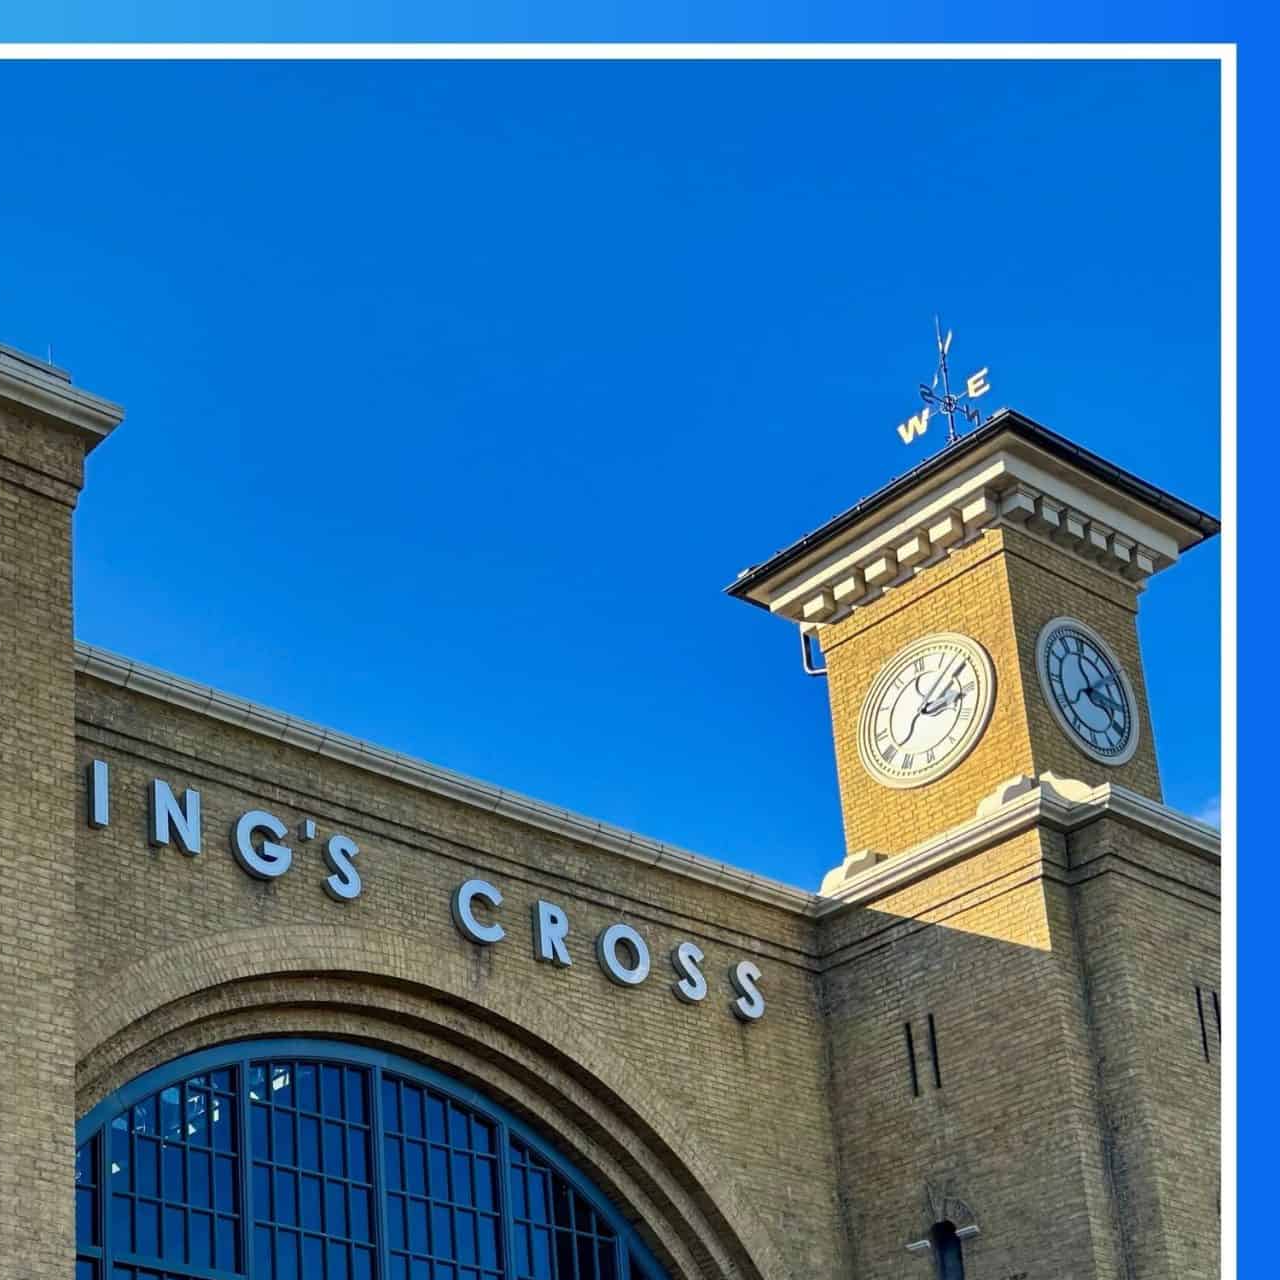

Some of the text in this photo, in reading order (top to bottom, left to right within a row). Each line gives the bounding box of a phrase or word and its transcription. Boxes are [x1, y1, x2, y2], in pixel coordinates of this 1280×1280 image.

[967, 367, 990, 398] E
[897, 407, 930, 445] W
[451, 878, 766, 1022] CROSS
